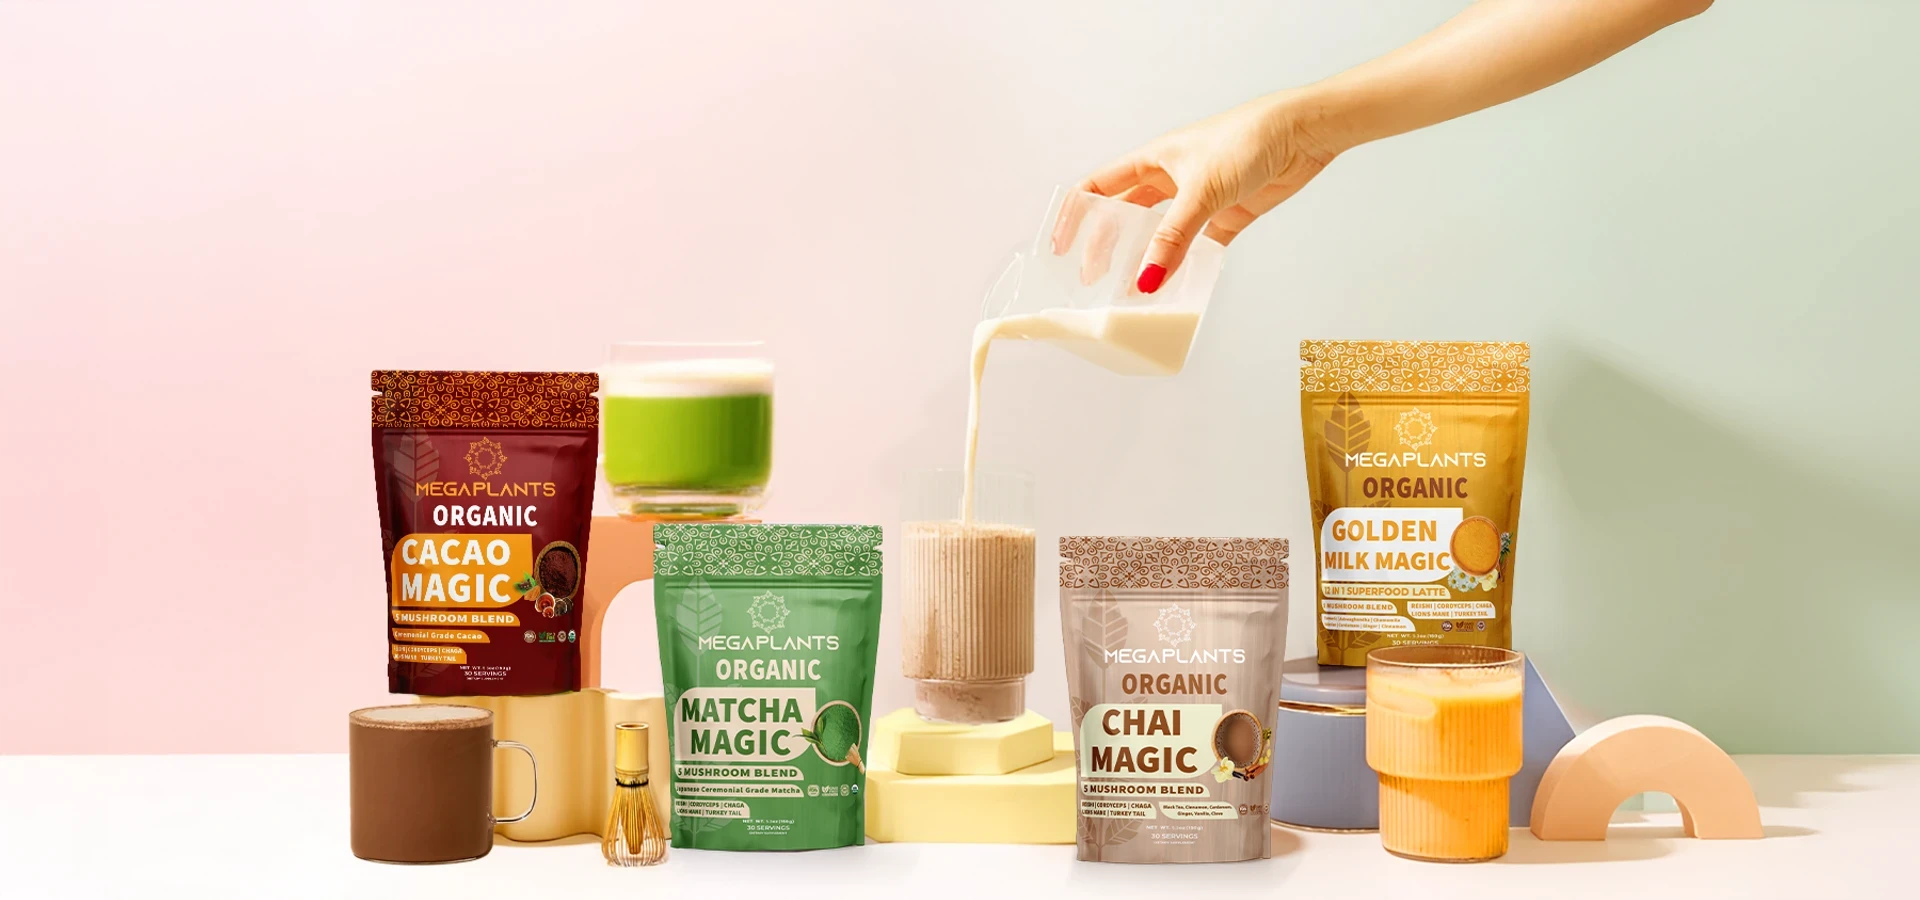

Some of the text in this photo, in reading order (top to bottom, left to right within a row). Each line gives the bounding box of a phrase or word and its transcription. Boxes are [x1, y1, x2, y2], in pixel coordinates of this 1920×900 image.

[1345, 452, 1486, 467] MEGAPLANTS
[416, 482, 556, 497] MEGAPLANTS
[1363, 477, 1467, 498] ORGANIC
[433, 505, 538, 526] ORGANIC
[1332, 520, 1437, 541] GOLDEN
[402, 539, 511, 566] CACAO
[1325, 552, 1450, 571] MILK MAGIC
[402, 573, 511, 602] MAGIC
[1325, 586, 1331, 595] 12
[1332, 587, 1339, 595] IN
[1347, 587, 1409, 596] SUPERFOOD
[1413, 588, 1446, 596] LATTE
[402, 614, 467, 622] MUSHROOM
[472, 615, 514, 624] BLEND
[699, 636, 839, 650] MEGAPLANTS
[1104, 649, 1246, 663] MEGAPLANTS
[716, 659, 821, 681] ORGANIC
[1122, 674, 1227, 695] ORGANIC
[682, 698, 803, 723] MATCHA
[1102, 709, 1181, 736] CHAI
[691, 729, 791, 756] MAGIC
[1092, 746, 1197, 773] MAGIC
[684, 768, 750, 777] MUSHROOM
[754, 769, 798, 777] BLEND
[1090, 786, 1156, 794] MUSHROOM
[1160, 786, 1204, 794] BLEND
